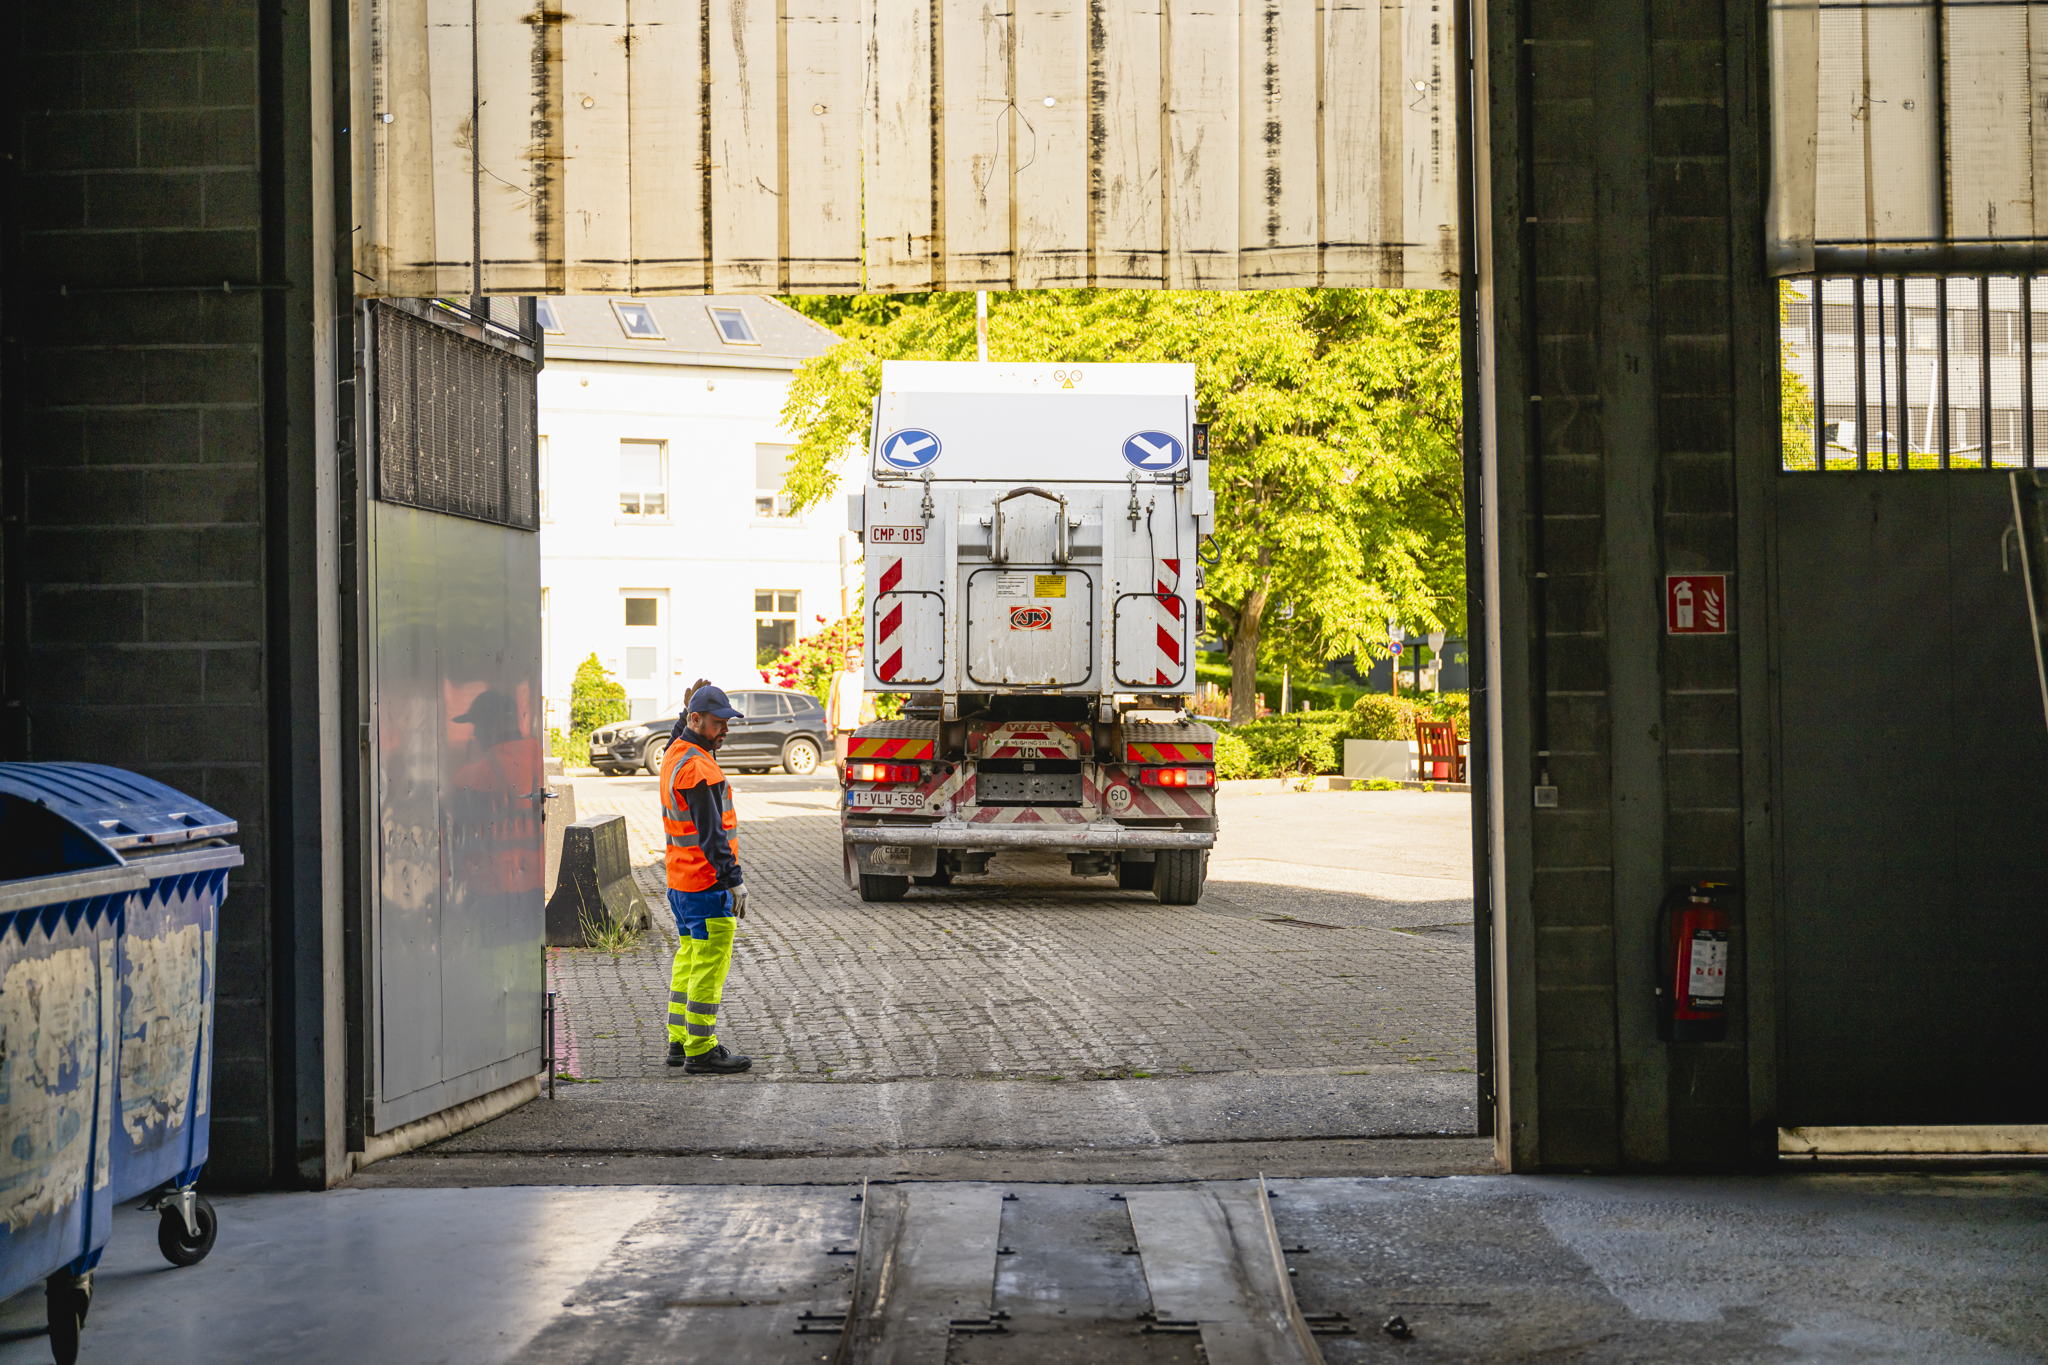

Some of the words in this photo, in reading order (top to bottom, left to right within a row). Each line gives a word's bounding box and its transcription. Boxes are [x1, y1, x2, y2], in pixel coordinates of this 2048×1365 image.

[1016, 611, 1045, 626] AJK
[1020, 747, 1040, 757] VDL
[1111, 790, 1127, 801] 60
